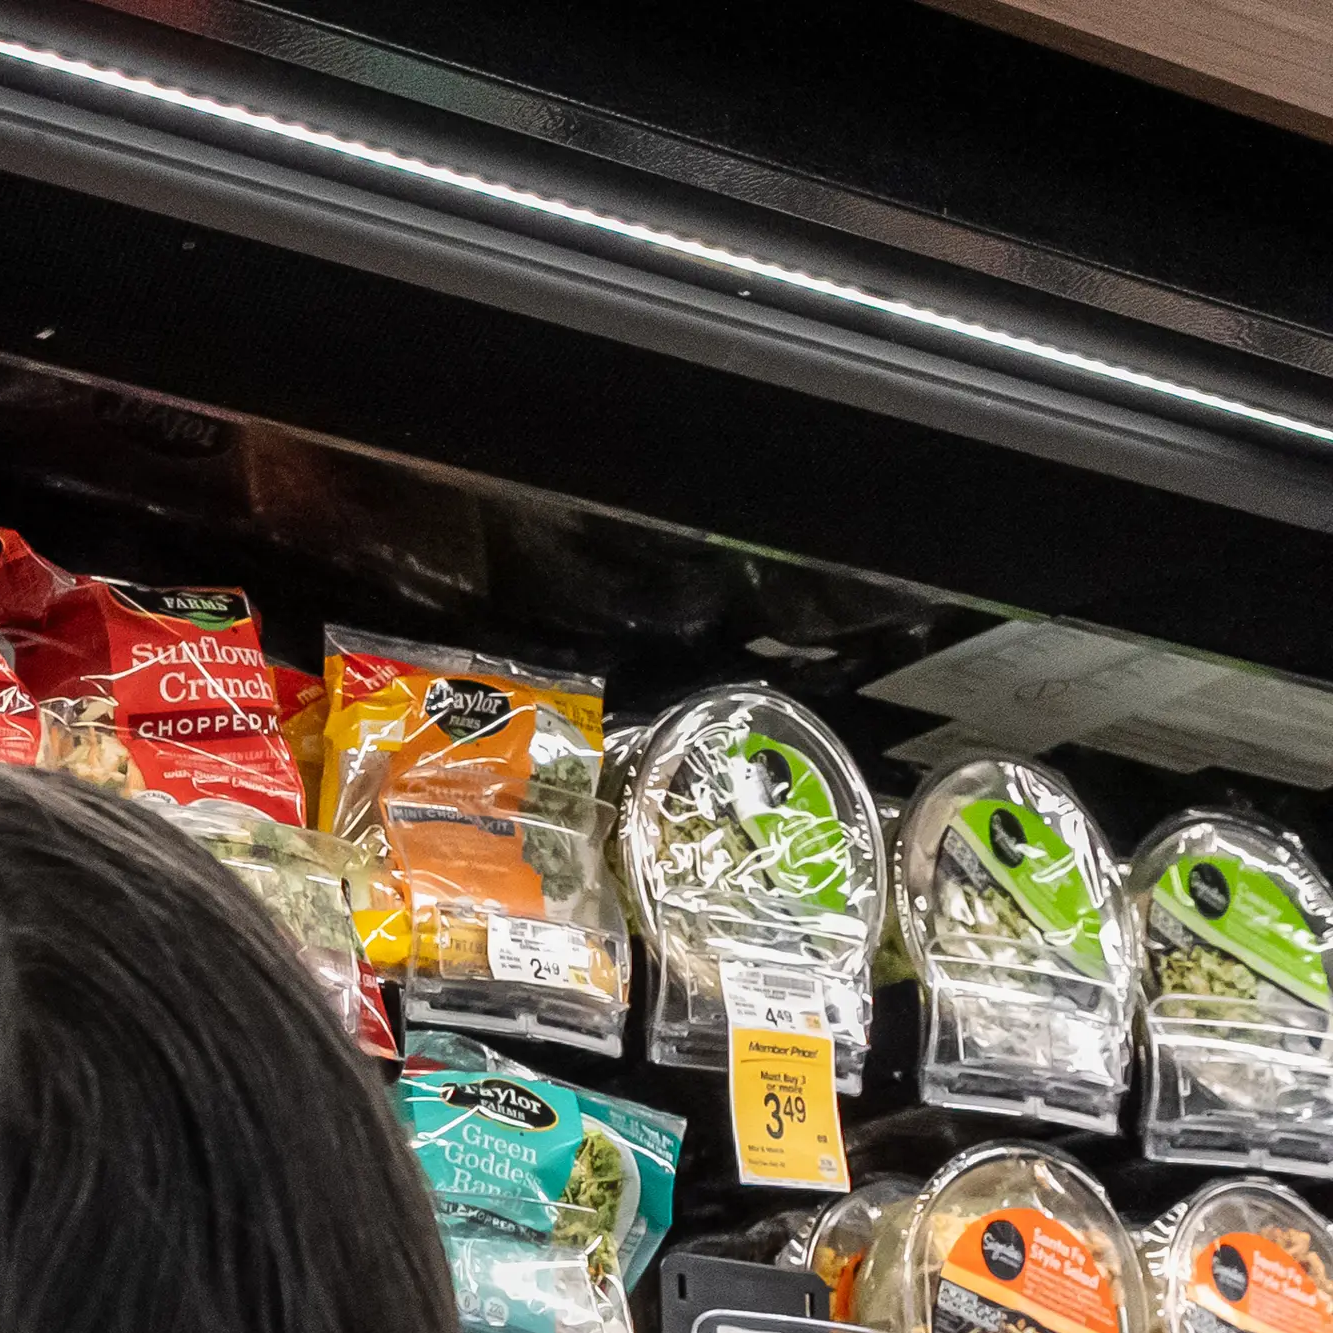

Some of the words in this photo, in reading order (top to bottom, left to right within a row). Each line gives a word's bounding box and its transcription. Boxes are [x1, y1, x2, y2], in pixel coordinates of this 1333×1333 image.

[163, 596, 228, 612] FARMS
[137, 713, 262, 738] CHOPPED
[461, 1123, 538, 1166] Green
[444, 1140, 542, 1192] Goddess
